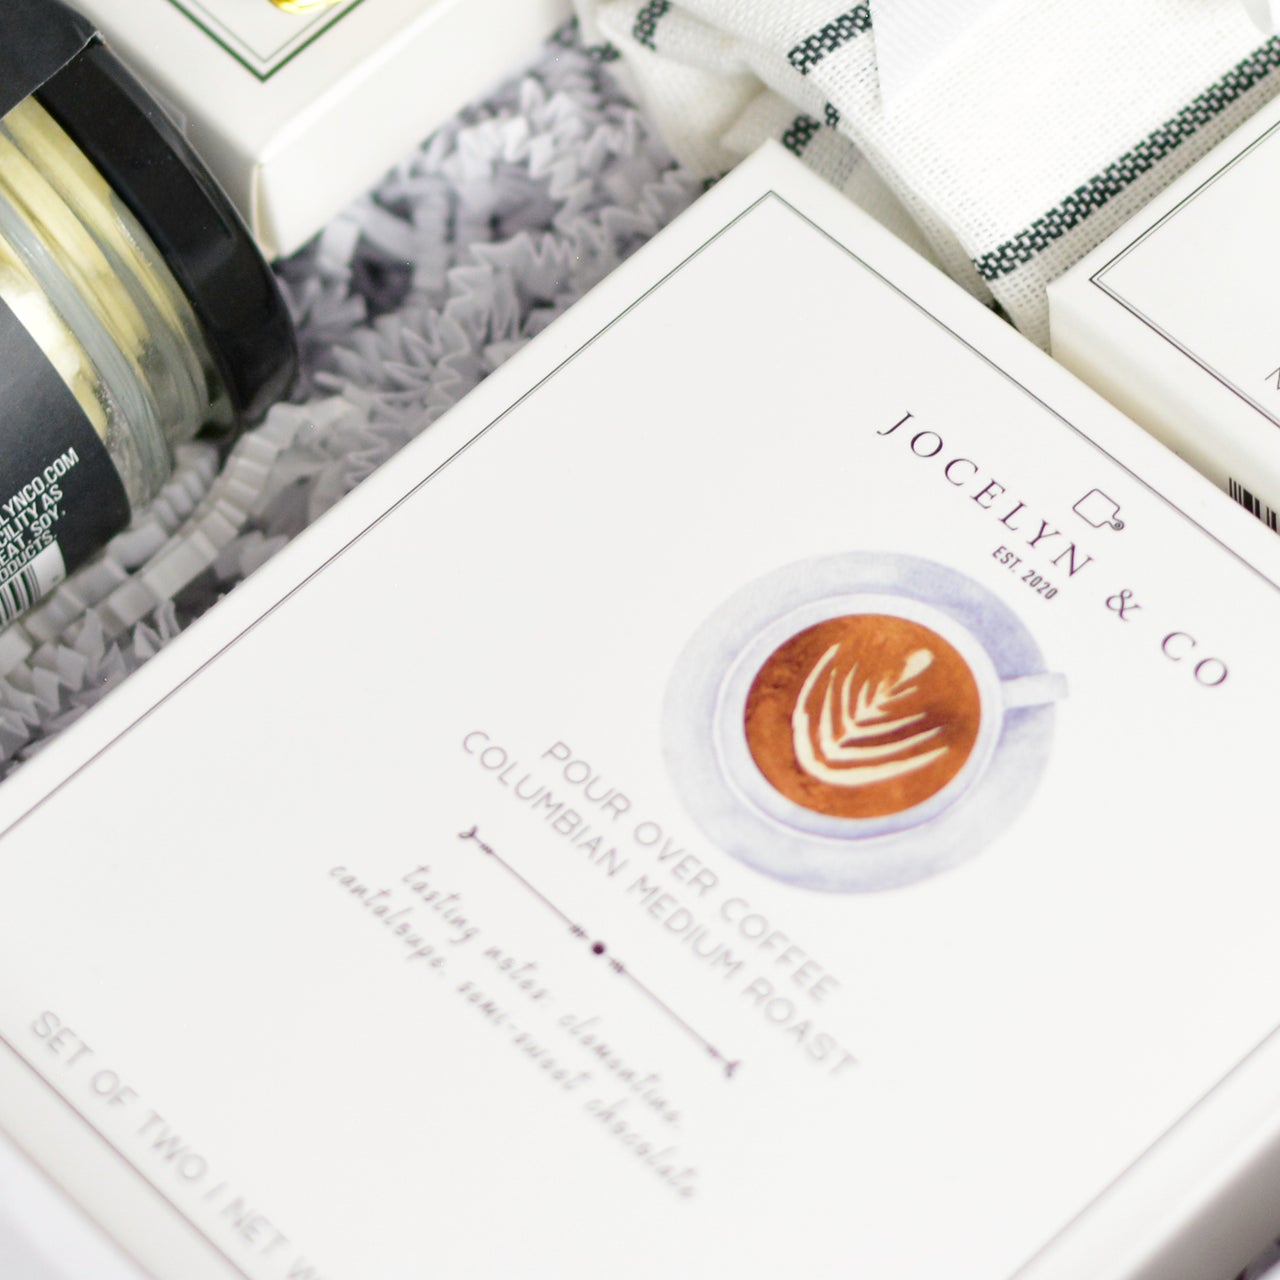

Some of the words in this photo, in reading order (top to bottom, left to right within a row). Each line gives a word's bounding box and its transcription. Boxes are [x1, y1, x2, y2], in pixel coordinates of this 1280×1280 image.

[41, 483, 63, 511] AS
[876, 411, 1094, 578] JOCELYN
[1105, 588, 1141, 621] &
[1161, 631, 1229, 687] CO
[992, 545, 1024, 574] EST.
[1021, 569, 1059, 600] 2020
[401, 865, 480, 944] tasting
[462, 731, 628, 878] COLUMBIAN
[626, 874, 745, 980] MEDIUM
[740, 976, 858, 1077] ROAST
[540, 740, 631, 821] POUR
[633, 821, 719, 897] OVER
[721, 897, 841, 1002] COFFEE
[30, 1010, 94, 1066] SET
[90, 1069, 138, 1107] OF
[136, 1109, 208, 1181] TWO
[221, 1195, 290, 1254] NET
